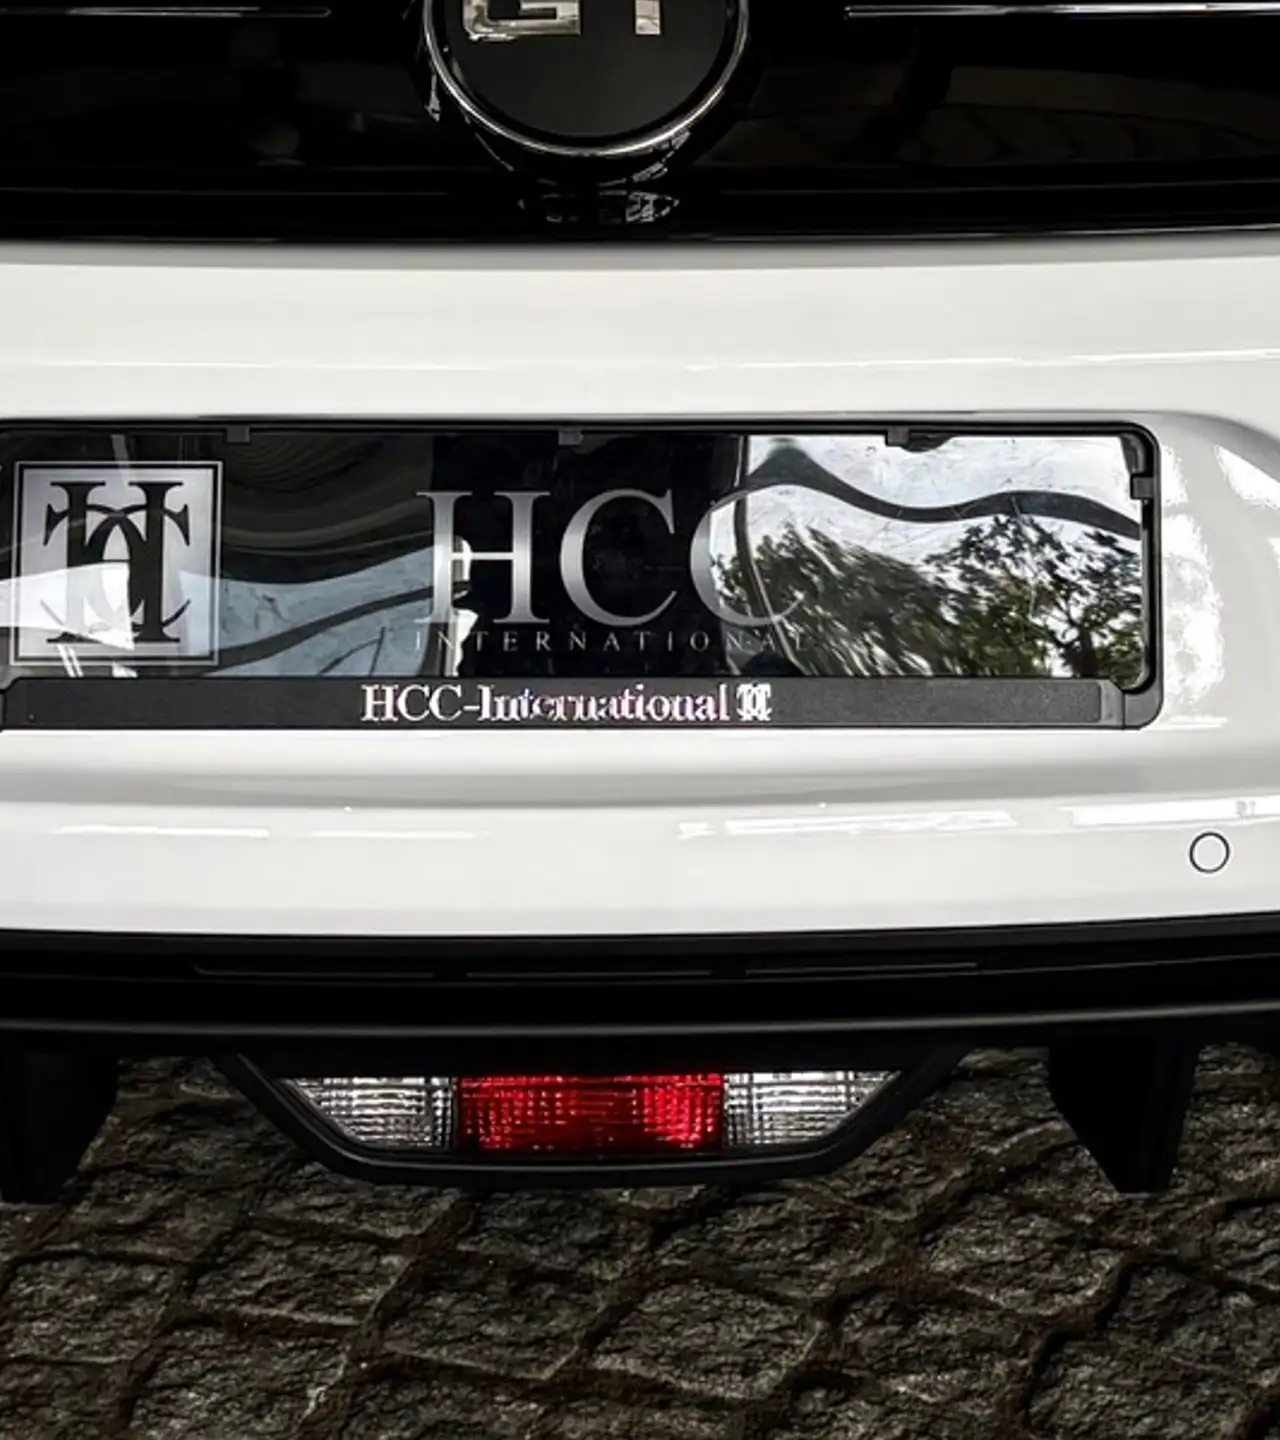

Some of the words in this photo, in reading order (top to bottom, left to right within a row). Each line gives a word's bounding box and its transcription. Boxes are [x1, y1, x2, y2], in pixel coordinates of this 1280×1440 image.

[415, 484, 806, 627] HCC
[415, 630, 811, 652] INTERNATIONAL
[361, 682, 731, 723] HCC-International
